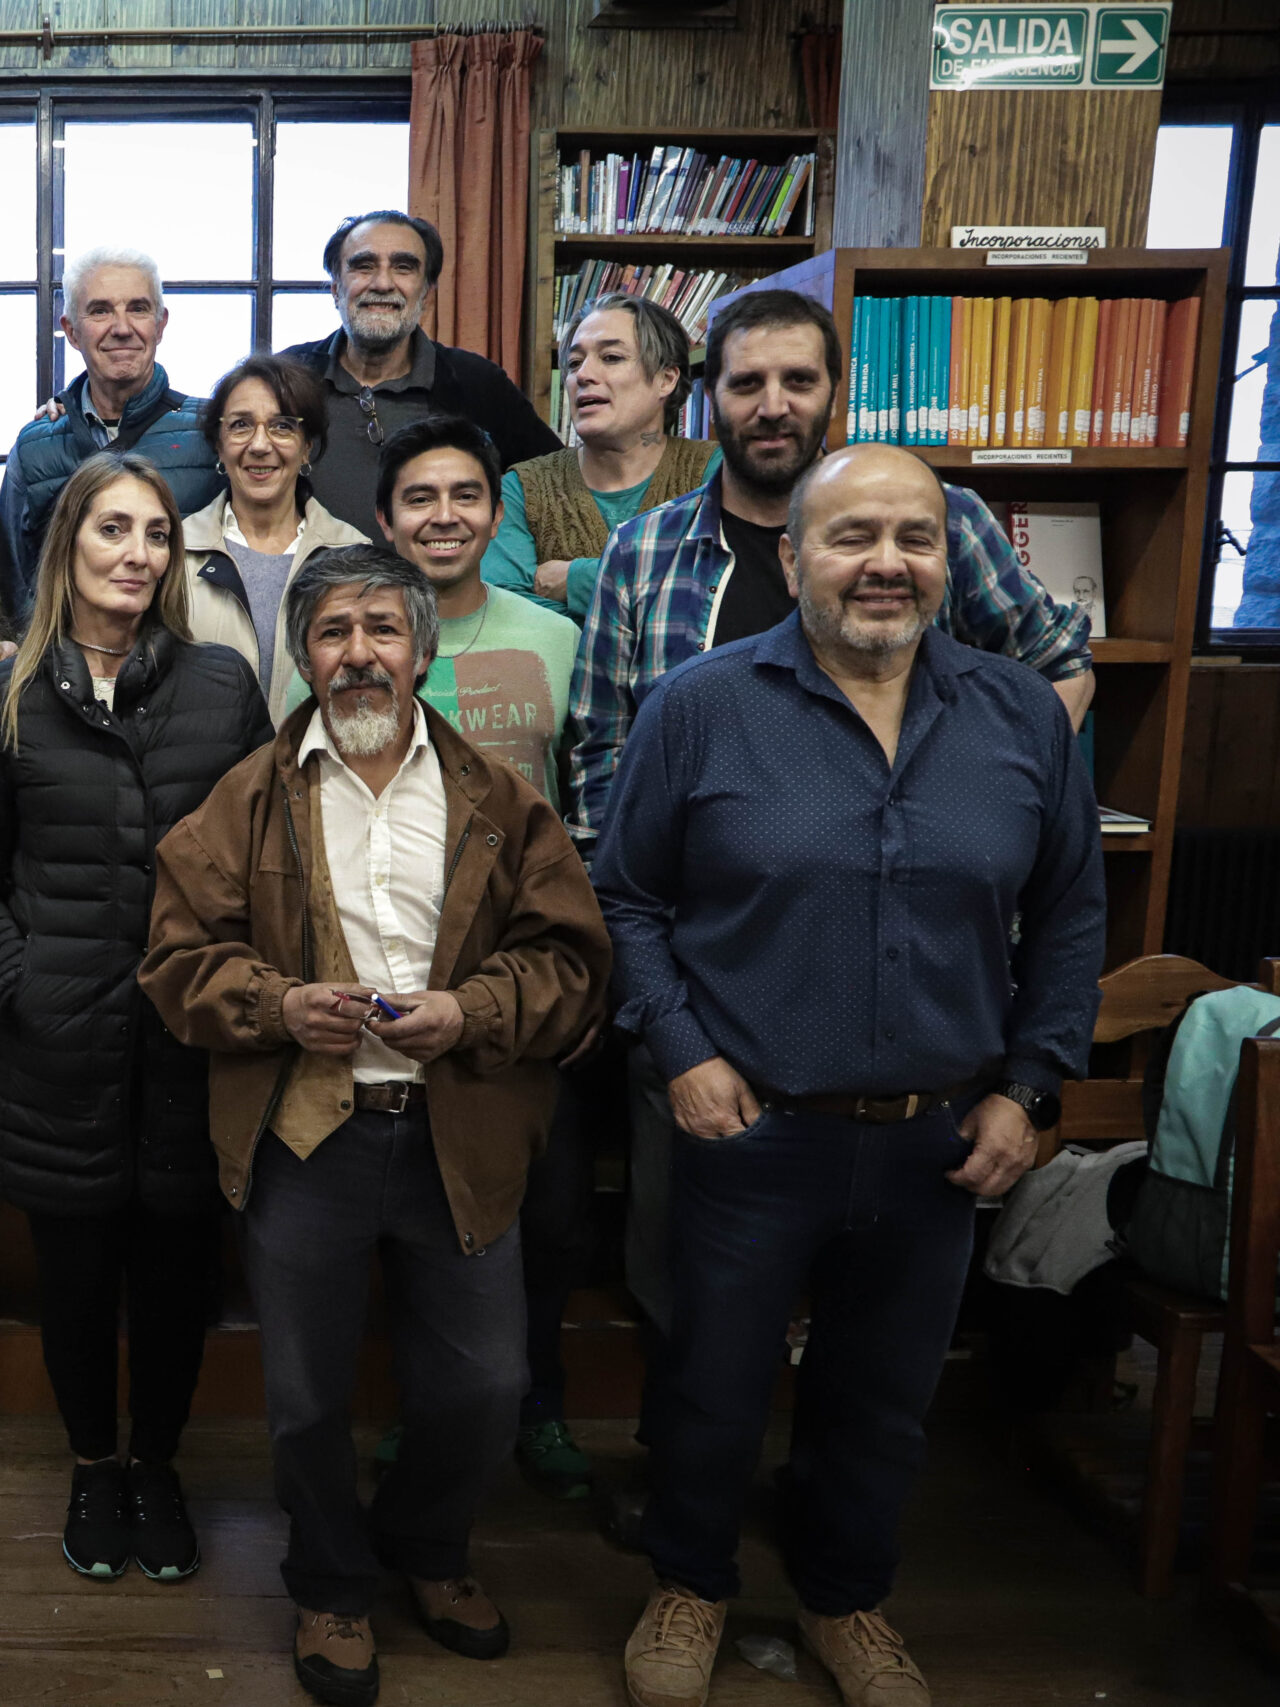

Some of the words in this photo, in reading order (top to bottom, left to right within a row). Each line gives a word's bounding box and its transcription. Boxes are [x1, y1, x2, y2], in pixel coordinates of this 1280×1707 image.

[948, 18, 1074, 55] SALIDA
[942, 58, 963, 76] DE
[970, 57, 1076, 77] EMGENCIA
[959, 228, 1100, 248] Incorporaciones
[442, 702, 538, 734] KWEAR
